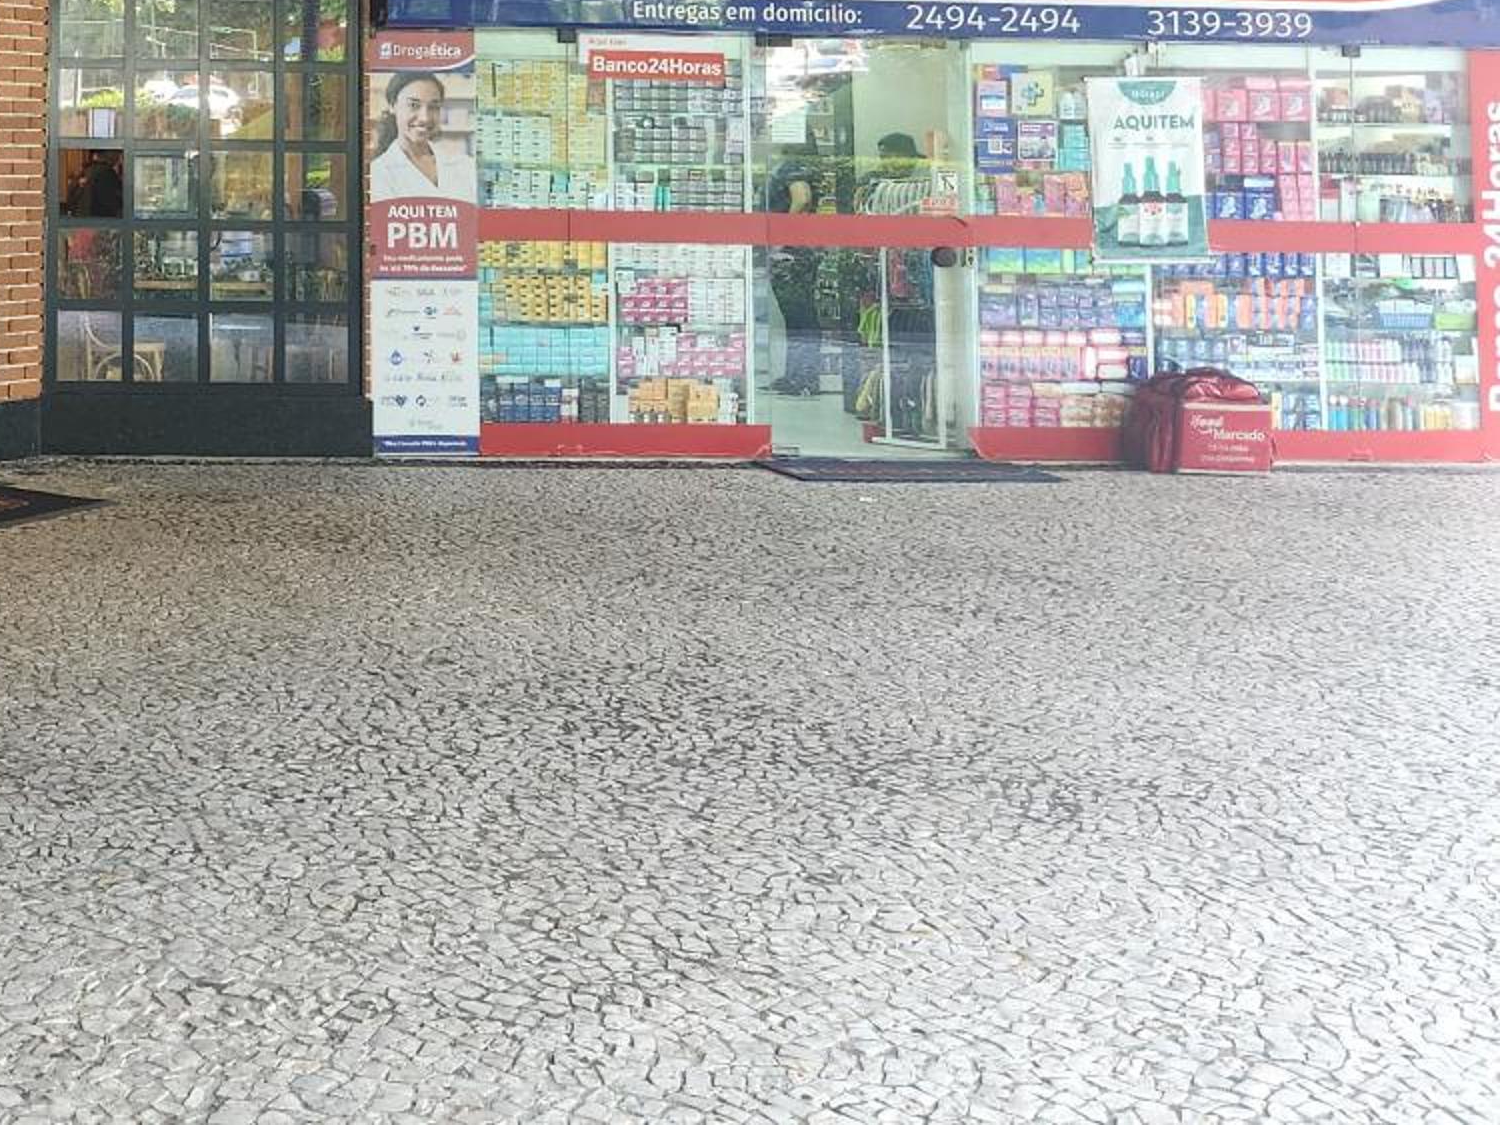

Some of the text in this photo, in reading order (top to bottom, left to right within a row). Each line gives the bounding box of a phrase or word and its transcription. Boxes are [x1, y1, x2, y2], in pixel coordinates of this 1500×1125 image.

[633, 0, 720, 23] Entregas
[726, 5, 755, 21] em
[906, 4, 1081, 33] 2494-2494
[1147, 10, 1313, 38] 3139-3939
[393, 42, 461, 59] DrogaÉtica
[593, 56, 723, 75] Banco24Horas
[388, 205, 457, 219] AQUI TEM
[388, 222, 458, 248] PBM
